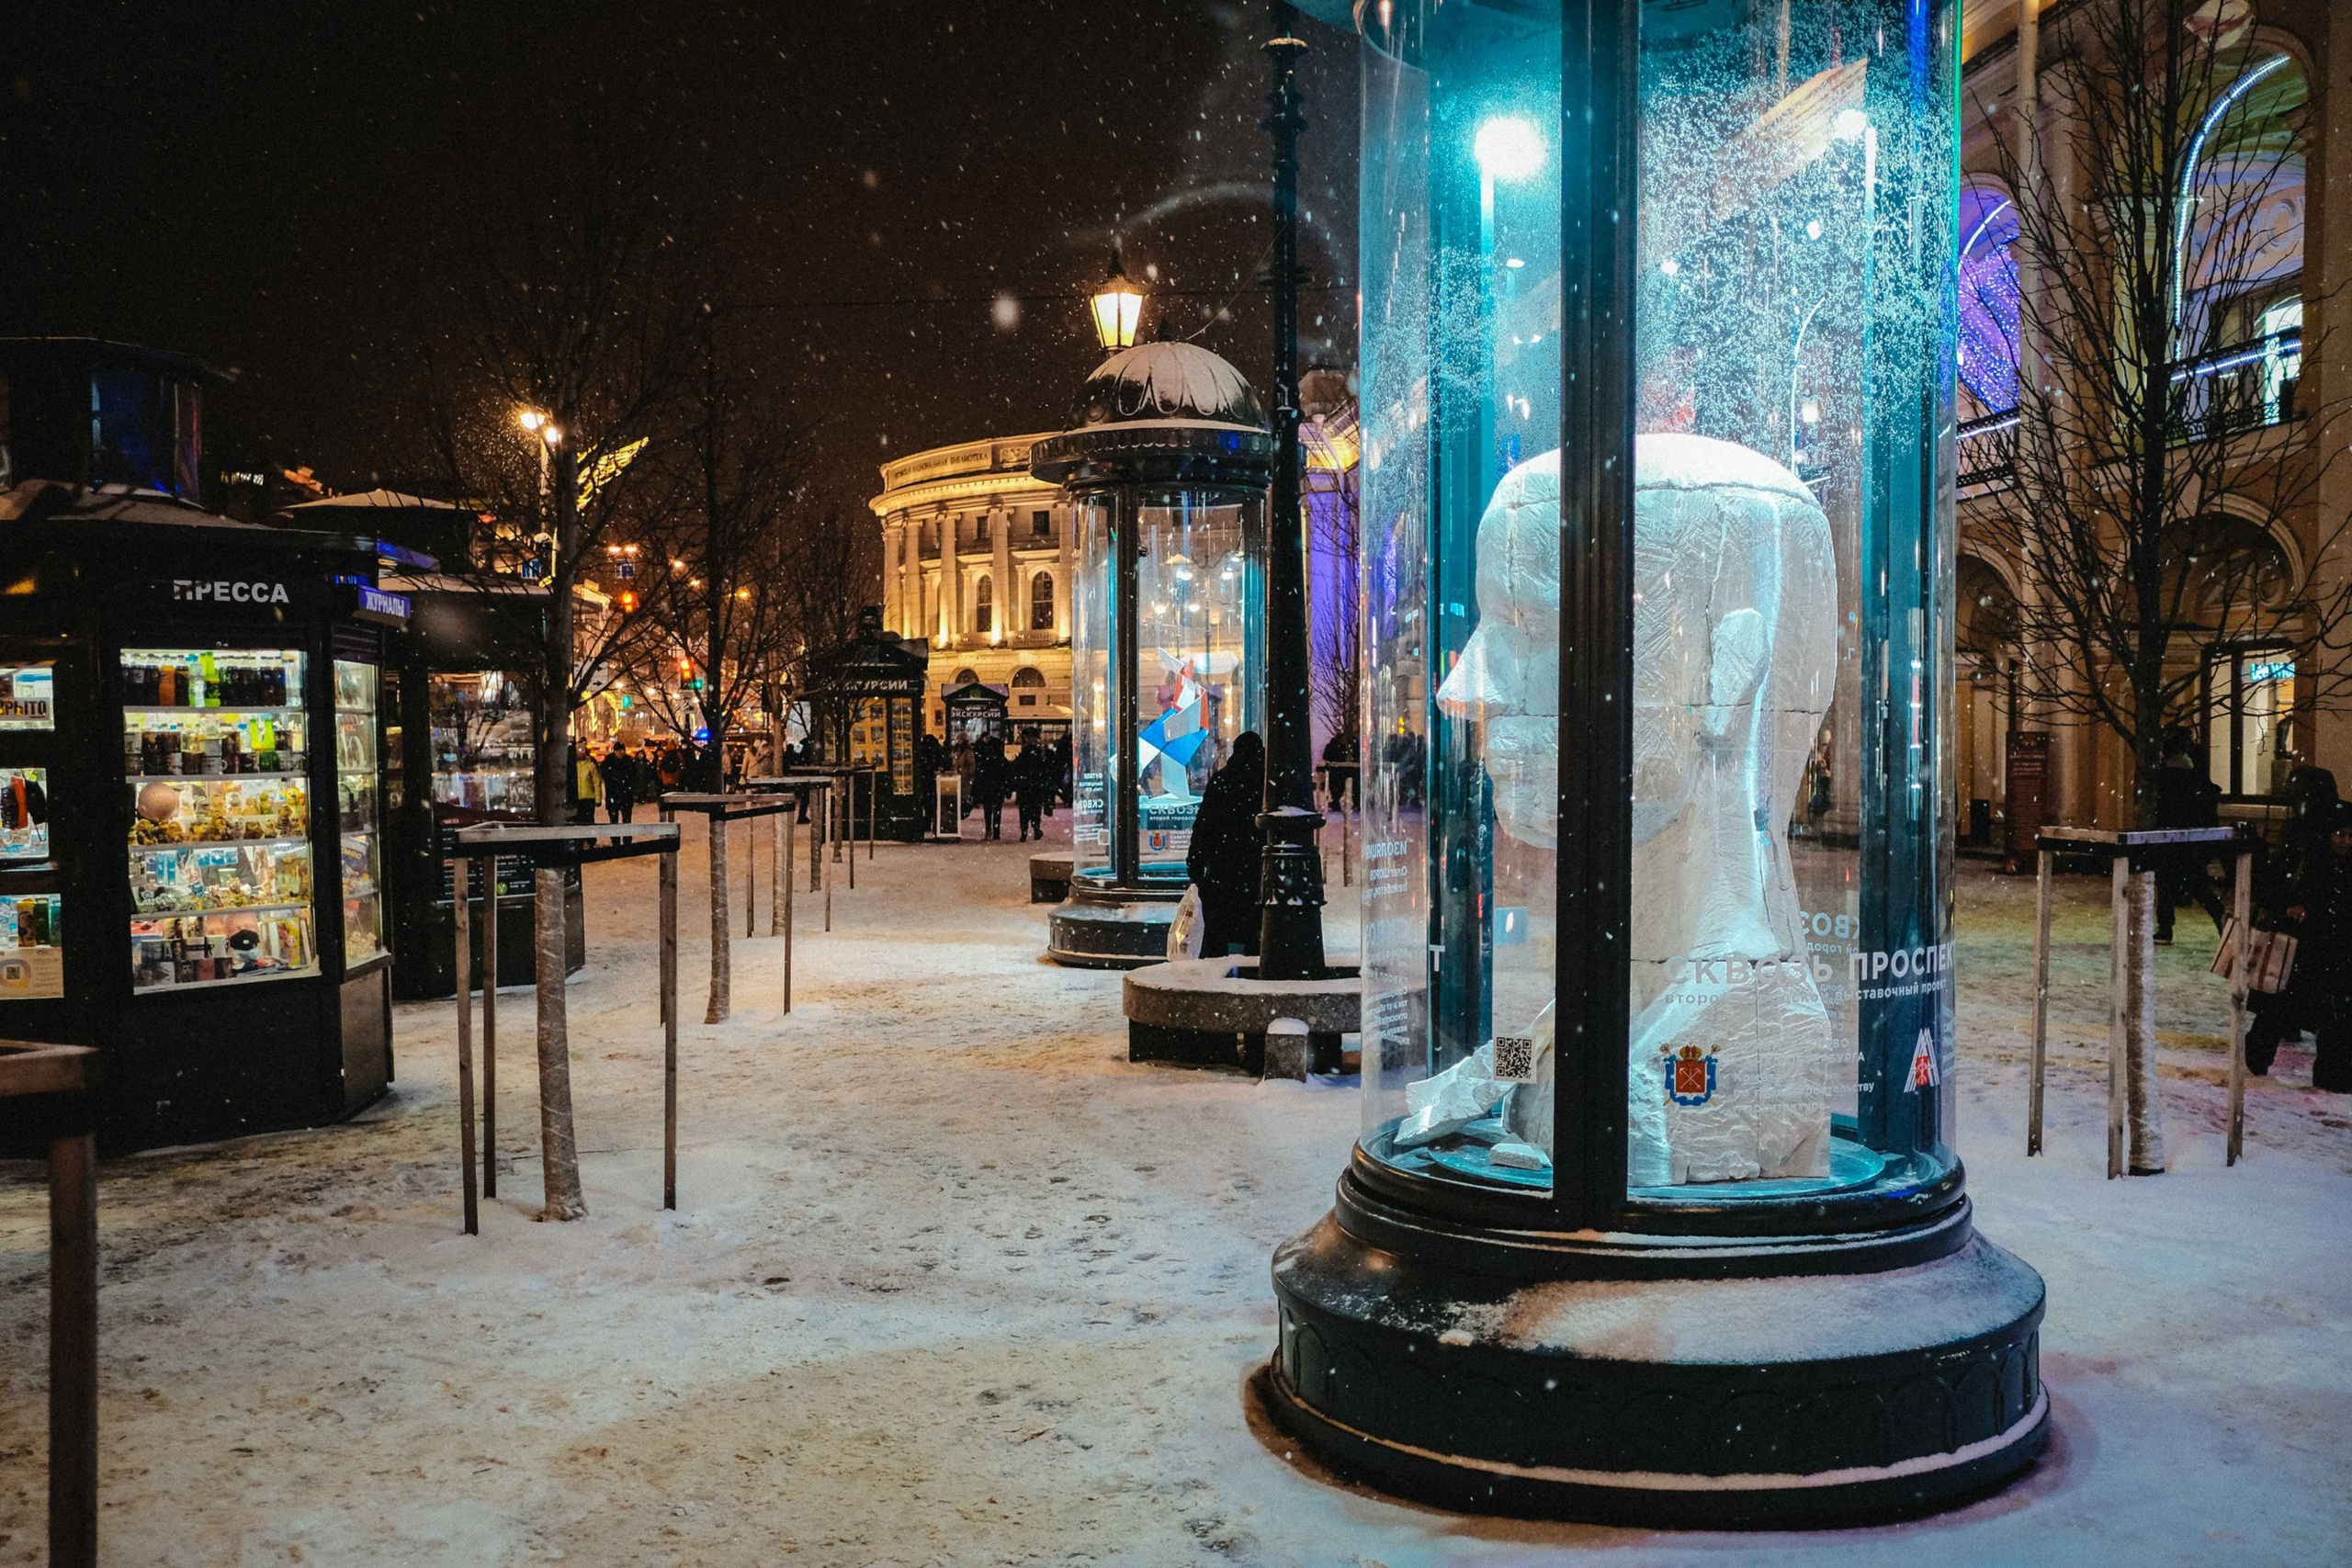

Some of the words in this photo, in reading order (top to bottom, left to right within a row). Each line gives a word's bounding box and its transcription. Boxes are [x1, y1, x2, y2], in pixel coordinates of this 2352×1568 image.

[173, 580, 289, 604] ПРЕССА
[366, 591, 405, 618] ЖУРНАЛЫ
[950, 710, 1001, 719] ЭКСКУРСИИ
[1664, 954, 1833, 985] СКВОЗЬ
[1849, 941, 1955, 981] ПРОСПЕК
[1666, 992, 1727, 1007] второ
[1838, 980, 1918, 1001] выставочный
[1922, 979, 1947, 995] проект
